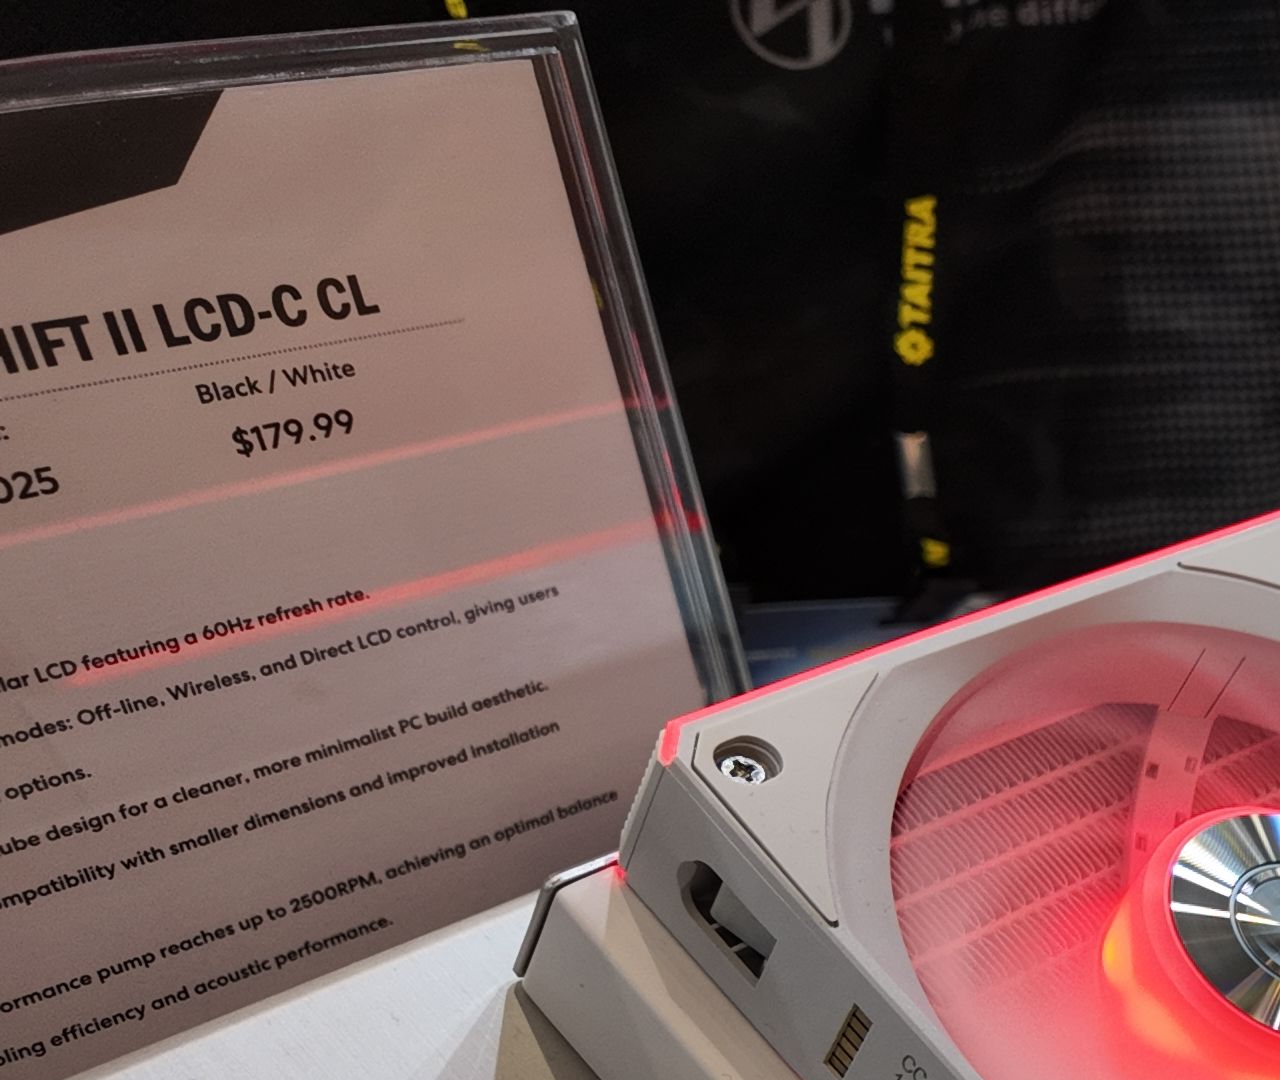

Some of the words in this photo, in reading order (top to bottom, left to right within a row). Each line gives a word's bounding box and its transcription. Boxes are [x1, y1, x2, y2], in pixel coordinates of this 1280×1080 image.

[103, 308, 148, 357] II
[152, 284, 308, 349] LCD-C
[316, 274, 381, 321] CL
[898, 194, 938, 330] TAITRA
[195, 376, 264, 405] Black
[269, 369, 276, 395] /
[282, 363, 357, 388] White
[231, 408, 355, 458] $179.99
[0, 672, 29, 693] lar
[33, 660, 78, 683] LCD
[81, 637, 181, 672] featuring
[184, 632, 198, 645] a
[202, 617, 255, 640] 60Hz
[257, 598, 324, 627] refresh
[326, 588, 370, 609] rate.
[77, 694, 166, 725] Off-line,
[166, 669, 257, 701] Wireless,
[260, 653, 298, 677] and
[300, 640, 355, 667] Direct
[357, 628, 392, 651] LCD
[396, 611, 461, 639] control,
[464, 597, 516, 623] giving
[518, 585, 560, 606] users
[0, 833, 41, 857] ube
[45, 811, 116, 843] design
[118, 801, 149, 820] for
[153, 796, 168, 809] a
[172, 772, 251, 804] cleaner,
[252, 756, 302, 780] more
[305, 724, 397, 764] minimalist
[398, 715, 423, 734] PC
[424, 701, 469, 727] build
[471, 679, 549, 712] aesthetic.
[0, 862, 116, 909] mpatibility
[120, 846, 166, 871] with
[168, 823, 240, 856] smaller
[243, 788, 347, 832] dimensions
[349, 775, 385, 798] and
[387, 749, 469, 786] improved
[471, 720, 561, 759] installation
[4, 766, 92, 800] options.
[96, 951, 156, 984] pump
[160, 924, 235, 959] reaches
[238, 913, 264, 932] up
[266, 906, 287, 922] to
[289, 871, 383, 914] 2500RPM,
[385, 841, 467, 881] achieving
[469, 834, 492, 852] an
[493, 809, 555, 844] optimal
[556, 788, 619, 821] balance
[50, 1003, 146, 1048] efficiency
[151, 986, 191, 1011] and
[194, 958, 272, 995] acoustic
[274, 915, 394, 970] performance.
